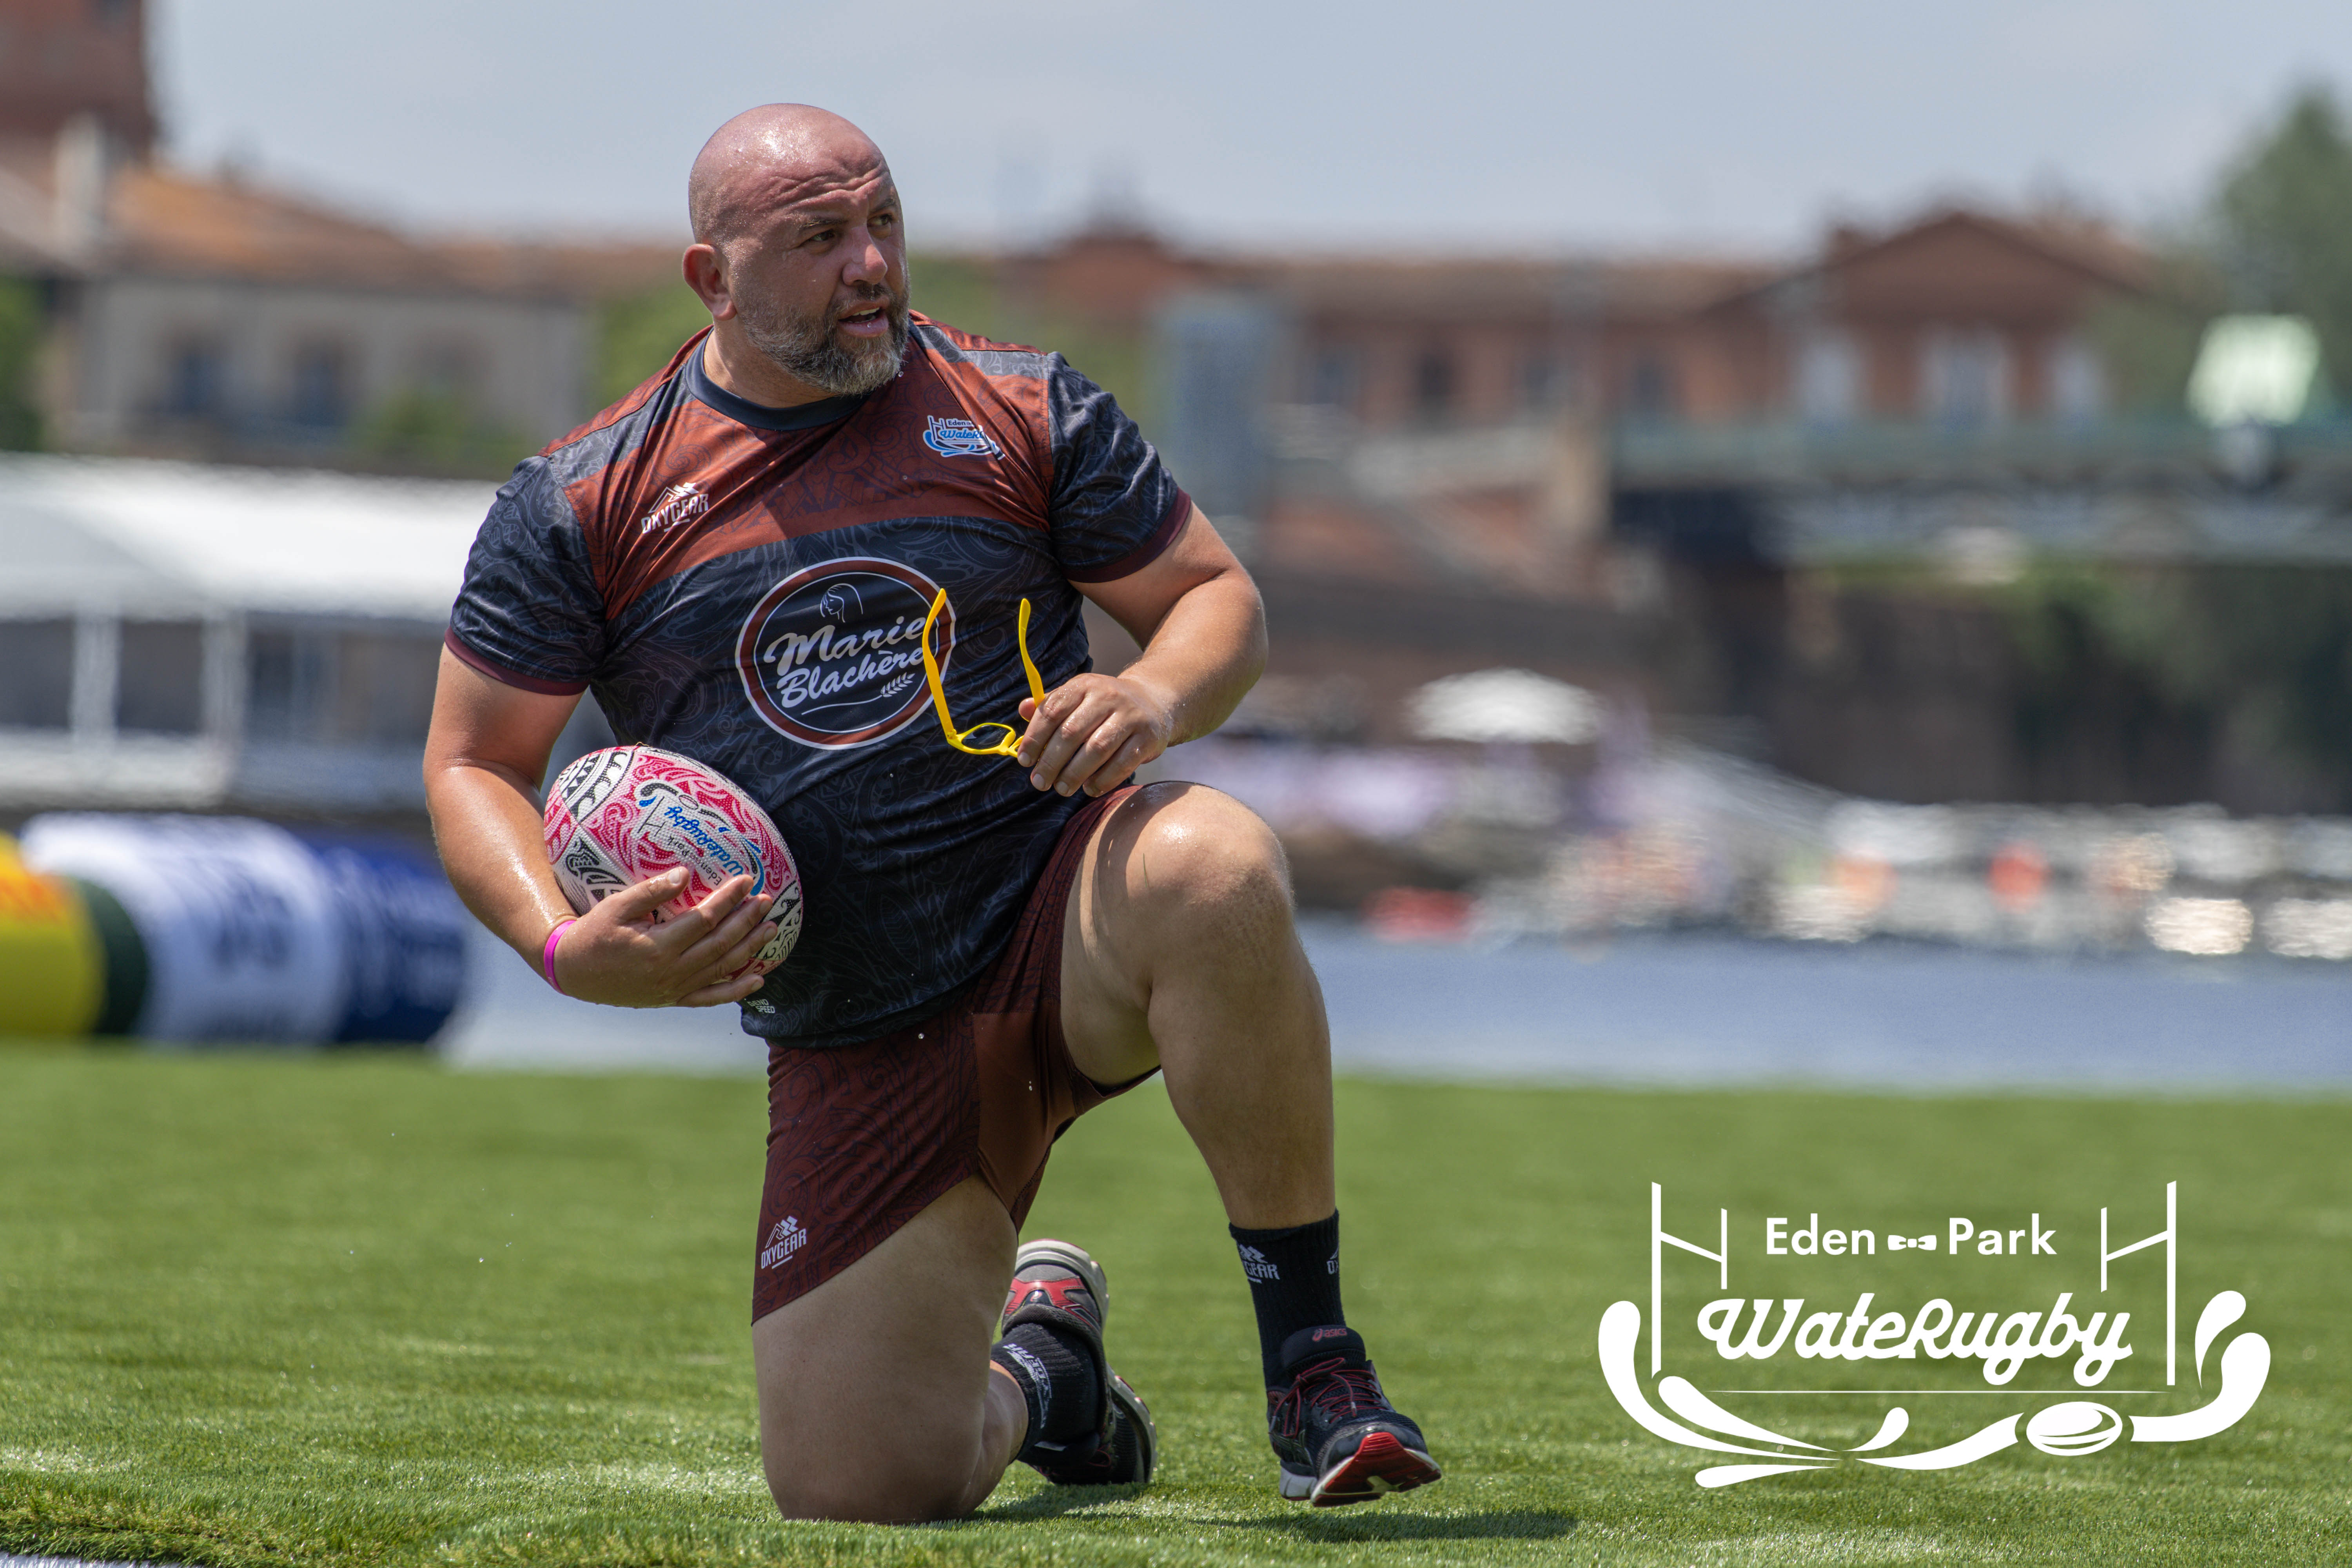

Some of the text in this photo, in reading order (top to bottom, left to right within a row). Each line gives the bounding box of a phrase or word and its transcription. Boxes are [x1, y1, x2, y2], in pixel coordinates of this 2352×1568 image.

[641, 494, 709, 534] OXYGEAR
[763, 616, 927, 676] Marie
[776, 647, 924, 708] Blachère
[667, 835, 722, 886] Eden Park
[761, 1228, 807, 1270] OXYGEAR
[1243, 1261, 1280, 1280] GEAR
[1324, 1328, 1347, 1337] asics
